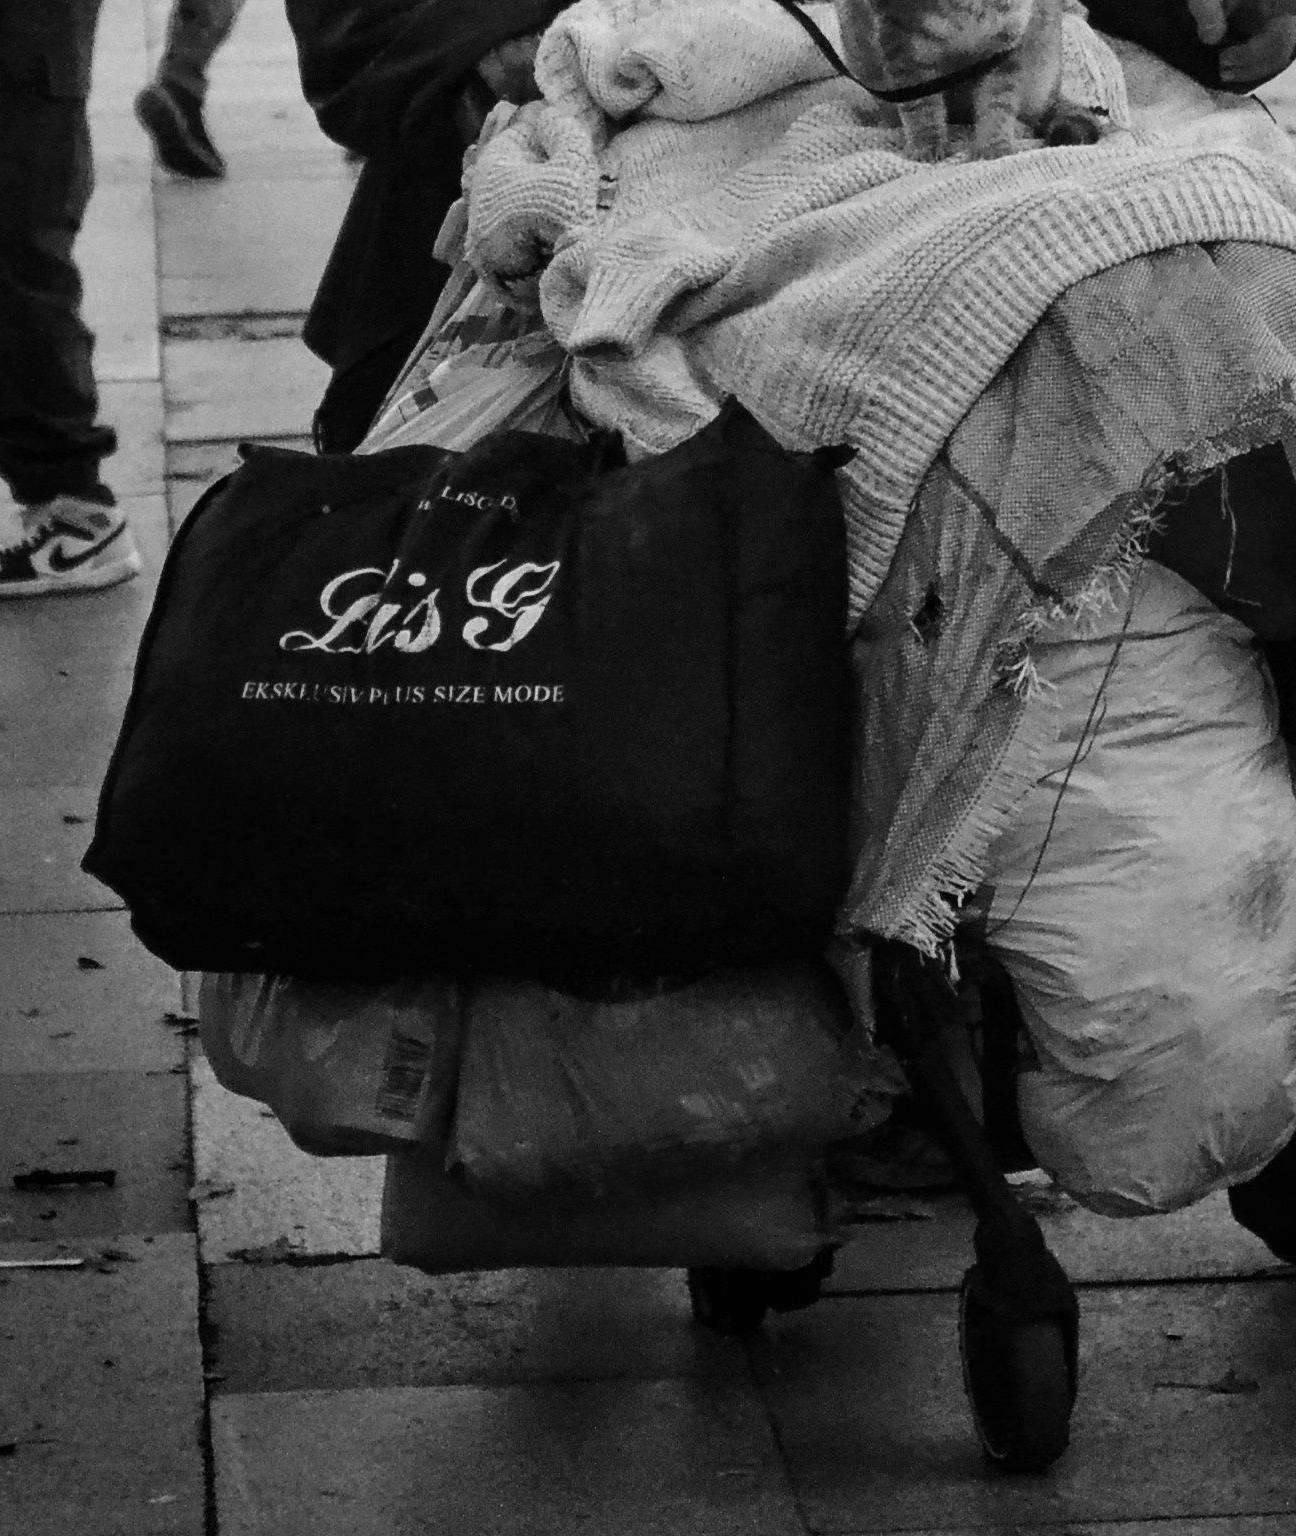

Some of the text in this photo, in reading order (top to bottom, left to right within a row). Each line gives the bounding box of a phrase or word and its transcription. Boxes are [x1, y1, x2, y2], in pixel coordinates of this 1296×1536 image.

[278, 557, 561, 654] Lis G
[432, 684, 486, 703] SIZE
[493, 684, 565, 704] MODE
